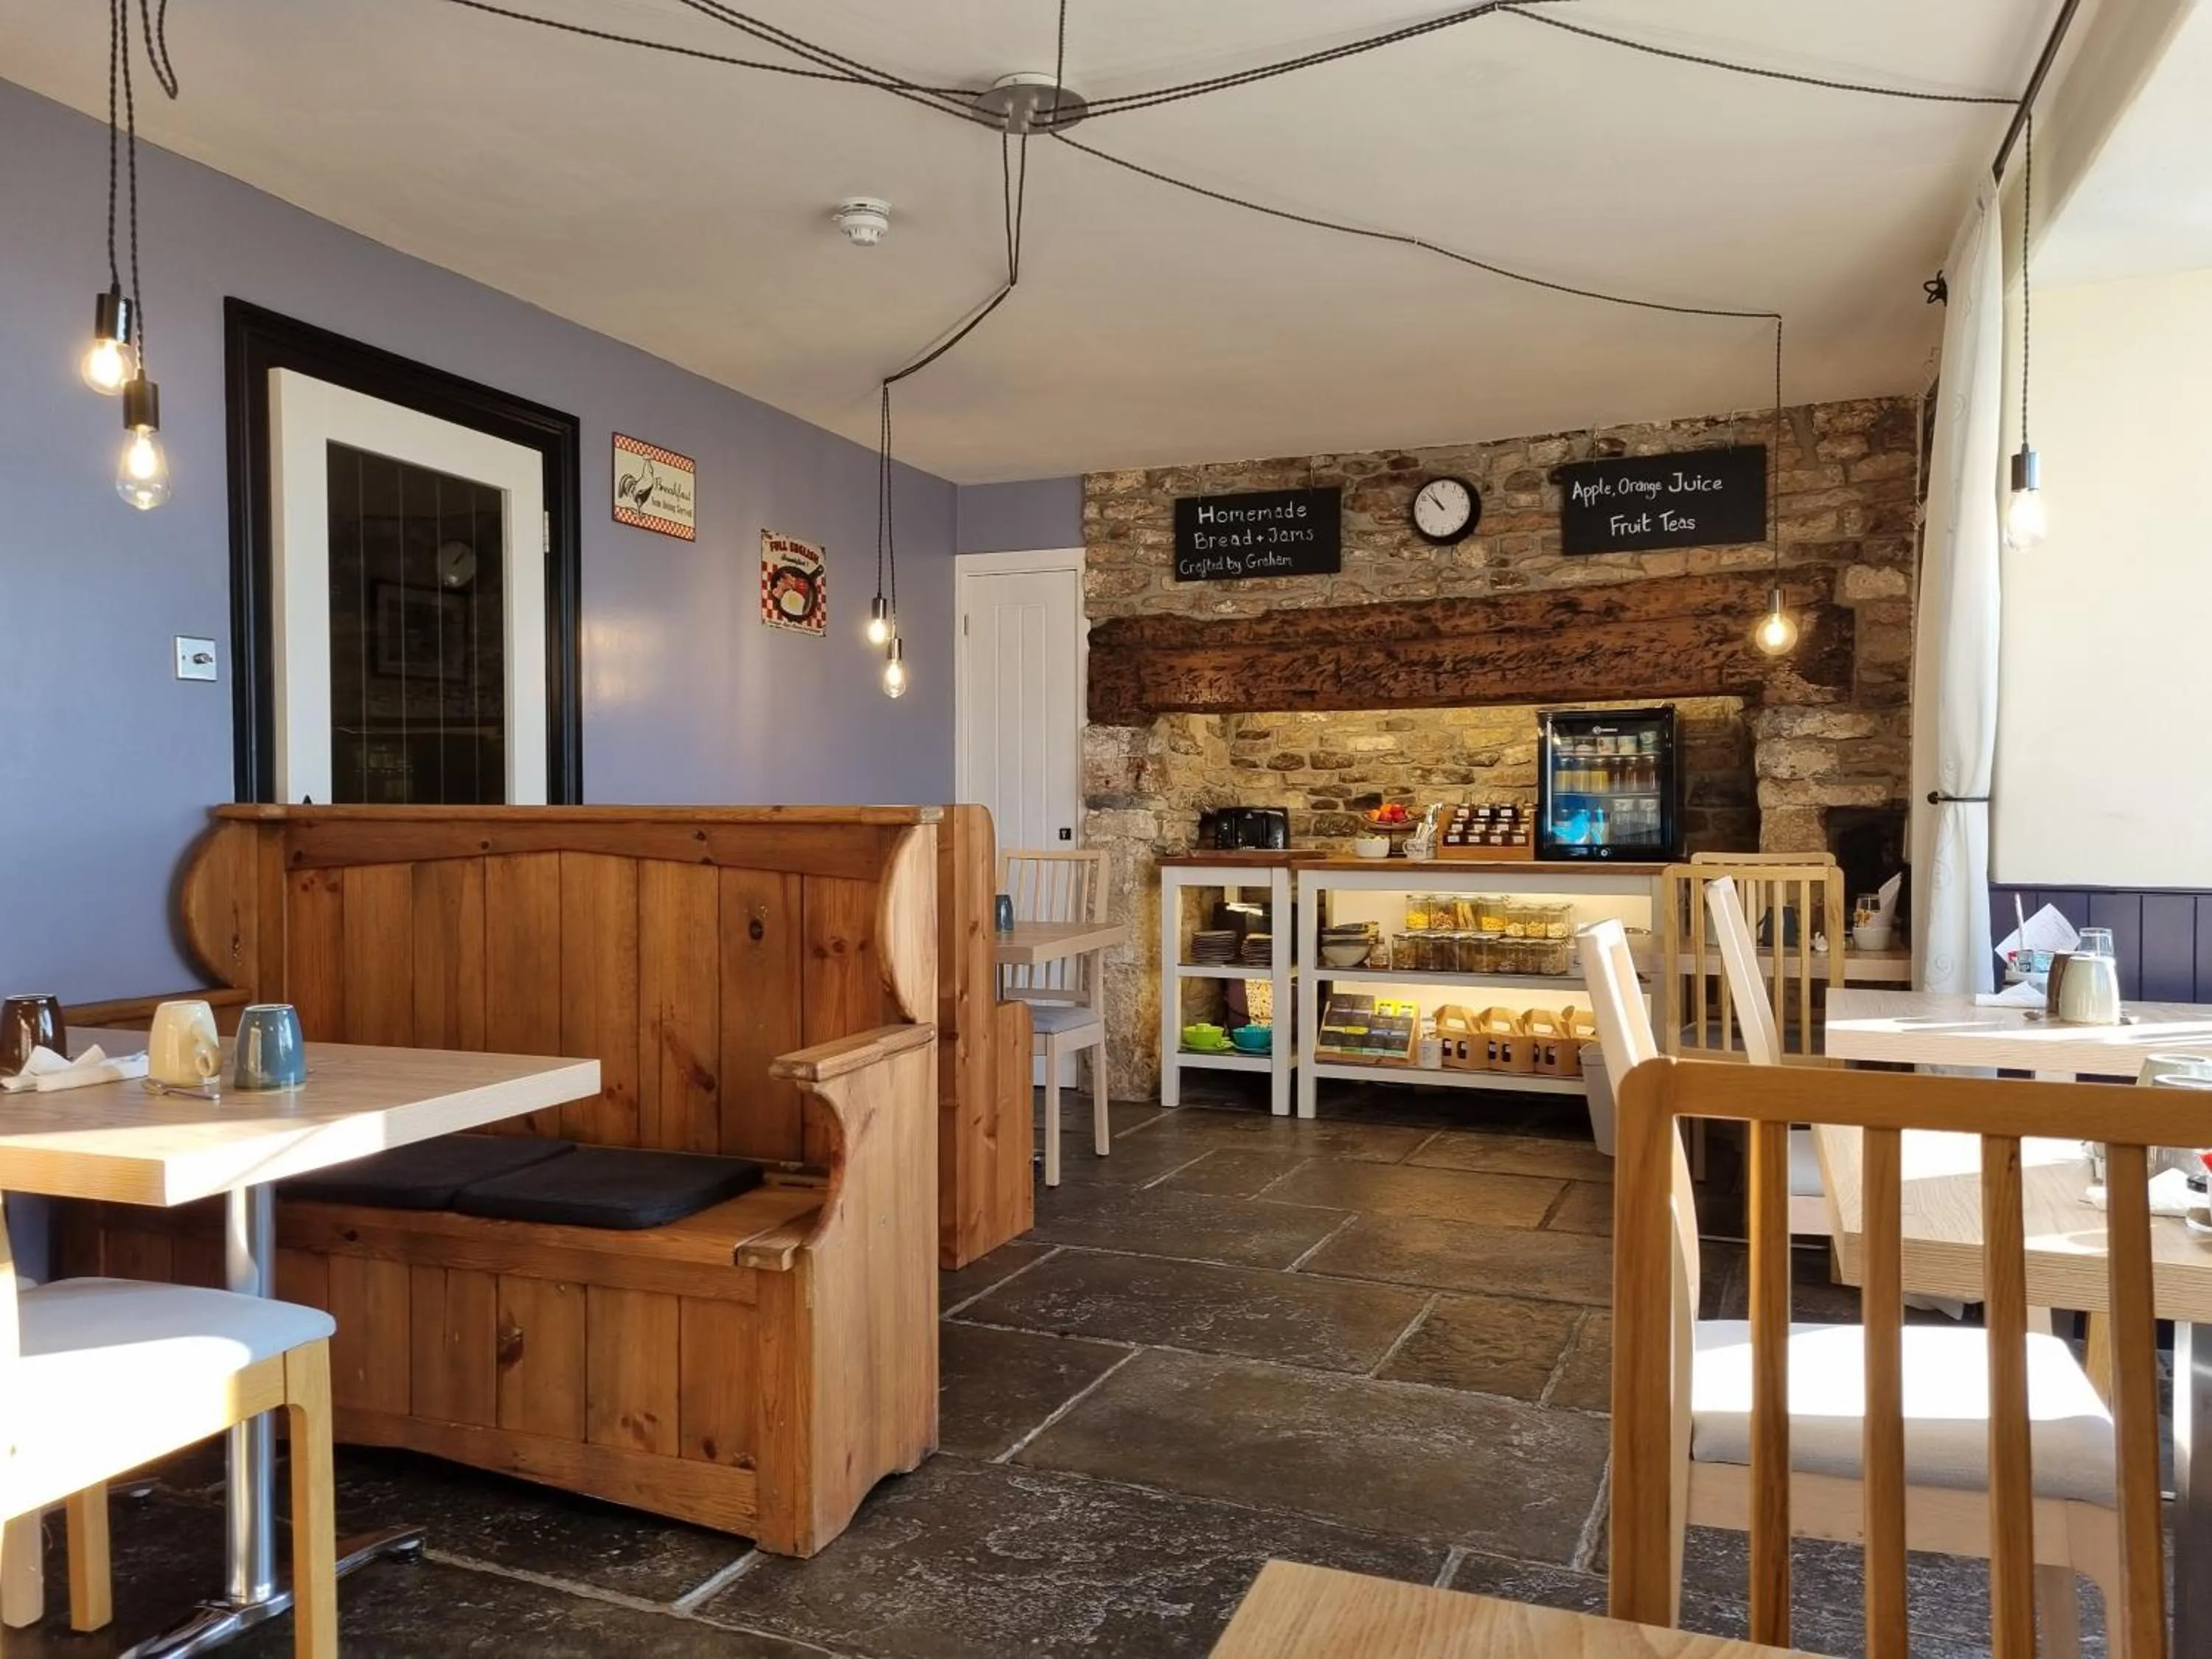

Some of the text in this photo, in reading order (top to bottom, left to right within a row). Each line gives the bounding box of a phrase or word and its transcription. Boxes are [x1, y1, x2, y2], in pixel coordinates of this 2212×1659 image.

[1618, 478, 1662, 499] Orange
[1669, 472, 1723, 493] Juice
[1198, 501, 1307, 524] Homemade
[1610, 510, 1696, 536] Fruit Teas
[1194, 527, 1314, 549] Bread + Jams
[1180, 551, 1293, 578] Crafted by Graham
